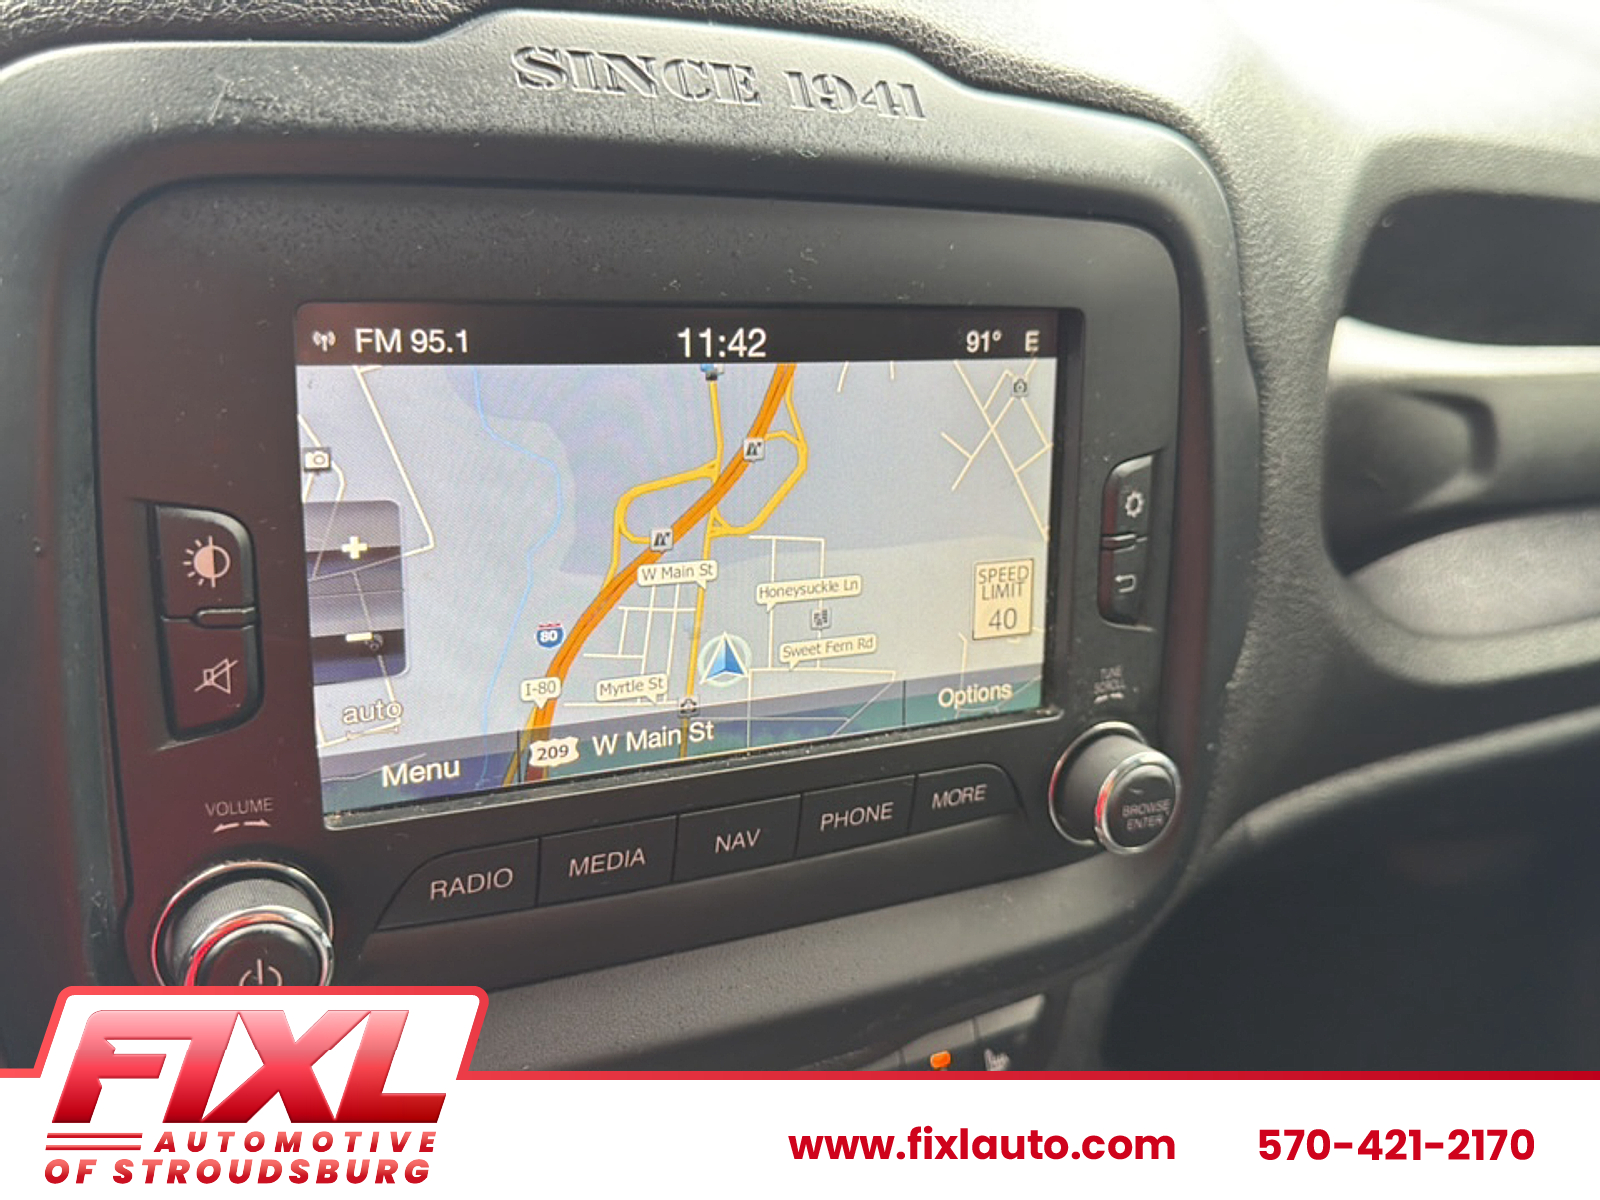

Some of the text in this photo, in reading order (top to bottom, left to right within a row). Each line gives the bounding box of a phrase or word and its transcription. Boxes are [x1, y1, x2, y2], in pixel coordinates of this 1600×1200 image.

[511, 45, 927, 122] SINCE 1941
[354, 328, 469, 354] FM 95.1
[677, 327, 768, 358] 11:42
[1024, 330, 1041, 353] E
[641, 562, 714, 582] W Main St
[977, 564, 1030, 584] SPEED
[758, 578, 860, 600] Honeysuckle Ln
[981, 581, 1026, 601] LIMIT
[988, 607, 1018, 631] 40
[539, 629, 559, 643] 80
[782, 636, 875, 660] Sweet Fern Rd
[524, 681, 557, 697] I-80
[599, 676, 664, 697] Myrtle St
[938, 681, 1014, 711] Options
[342, 700, 404, 725] auto
[592, 721, 715, 756] W Main St
[536, 746, 570, 761] 209
[381, 758, 462, 788] Menu
[205, 798, 274, 817] VOLUME
[931, 783, 988, 809] MORE
[820, 802, 895, 832] PHONE
[1122, 800, 1170, 817] BROWSE
[1126, 814, 1164, 831] ENTER
[714, 828, 762, 854] NAV
[568, 846, 647, 878] MEDIA
[430, 868, 514, 900] RADIO
